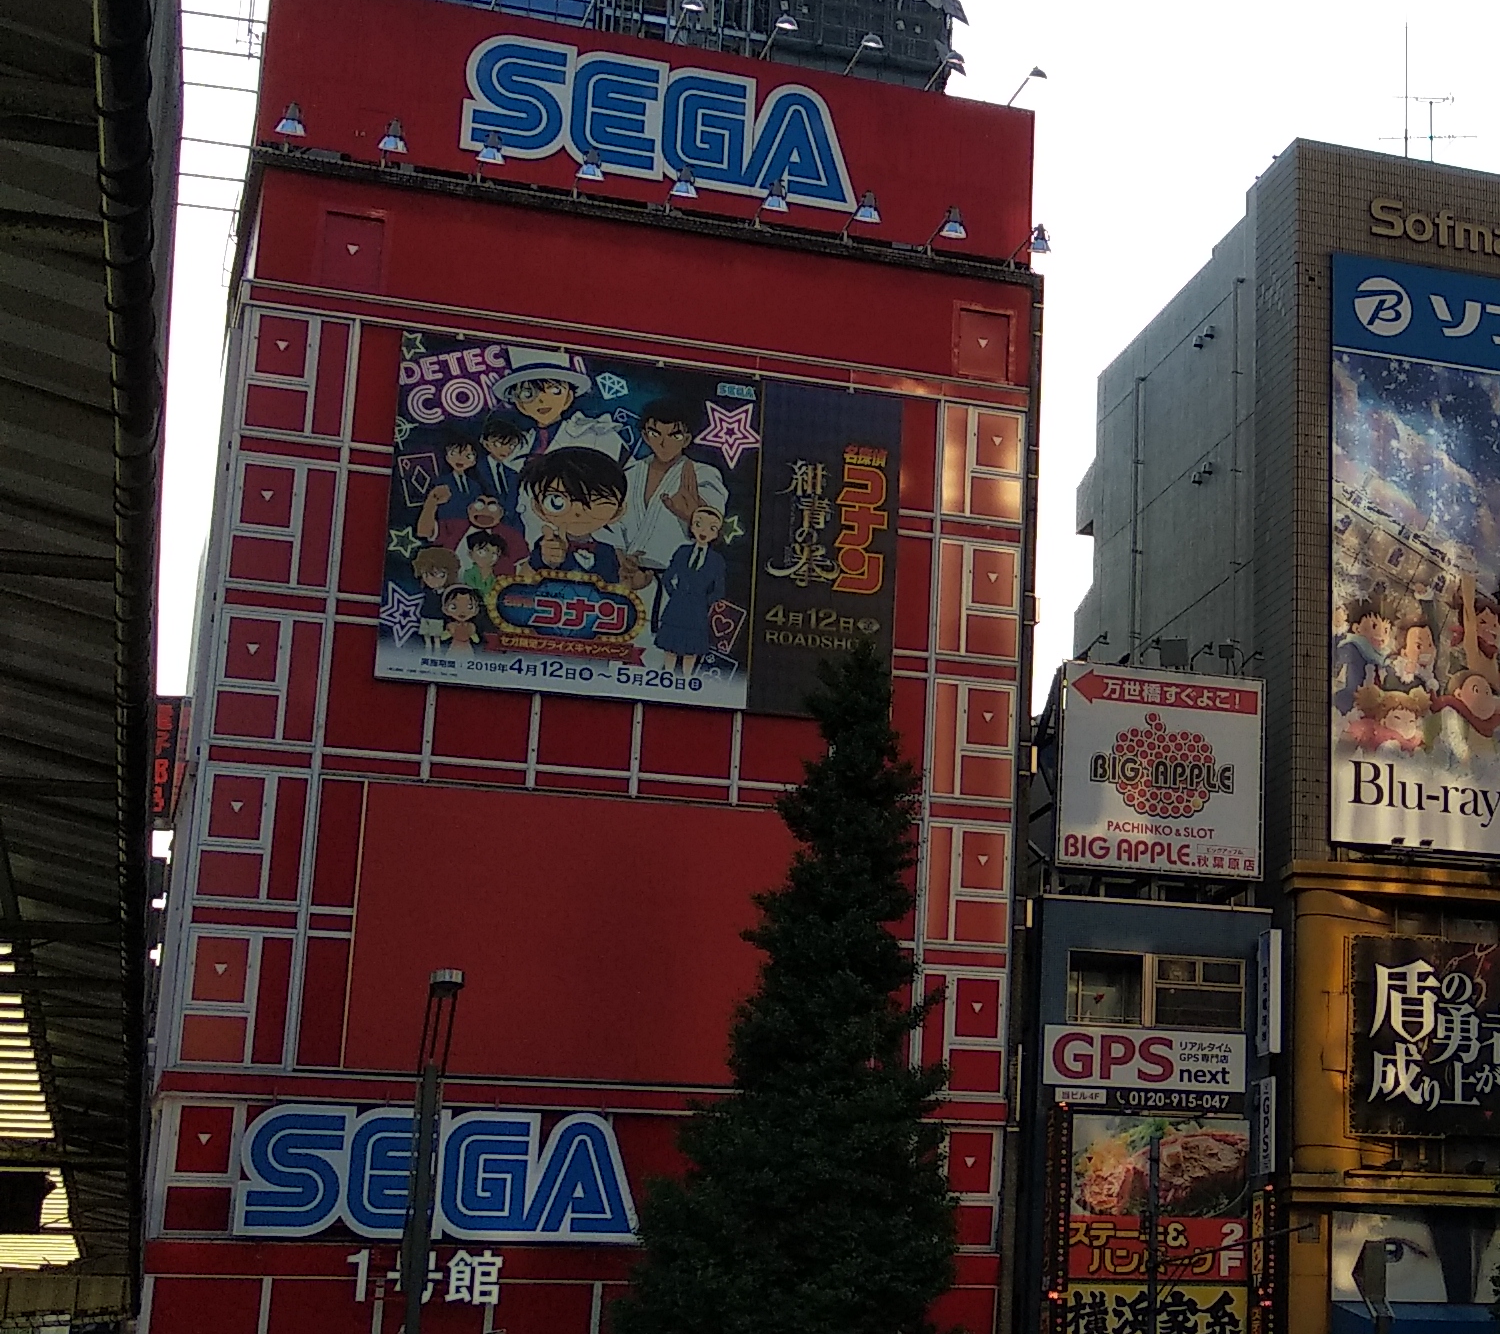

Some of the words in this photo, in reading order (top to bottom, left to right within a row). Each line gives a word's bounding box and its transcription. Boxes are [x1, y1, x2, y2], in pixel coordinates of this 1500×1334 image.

[460, 34, 857, 213] SEGA
[832, 464, 889, 595] コナン
[528, 596, 629, 634] コナン
[1090, 752, 1143, 784] BIG
[1152, 760, 1235, 794] APPLE
[1107, 820, 1172, 837] PACHINKO
[1175, 828, 1182, 837] &
[1184, 827, 1215, 839] SLOT
[1064, 834, 1111, 859] BIG
[1052, 1031, 1174, 1083] GPS
[1179, 1040, 1232, 1054] リアルタイム
[1179, 1053, 1199, 1064] GPS
[1201, 1052, 1230, 1065] 専門店
[1178, 1065, 1230, 1086] next
[1129, 1092, 1230, 1109] 0120-915-047
[233, 1104, 641, 1246] SEGA
